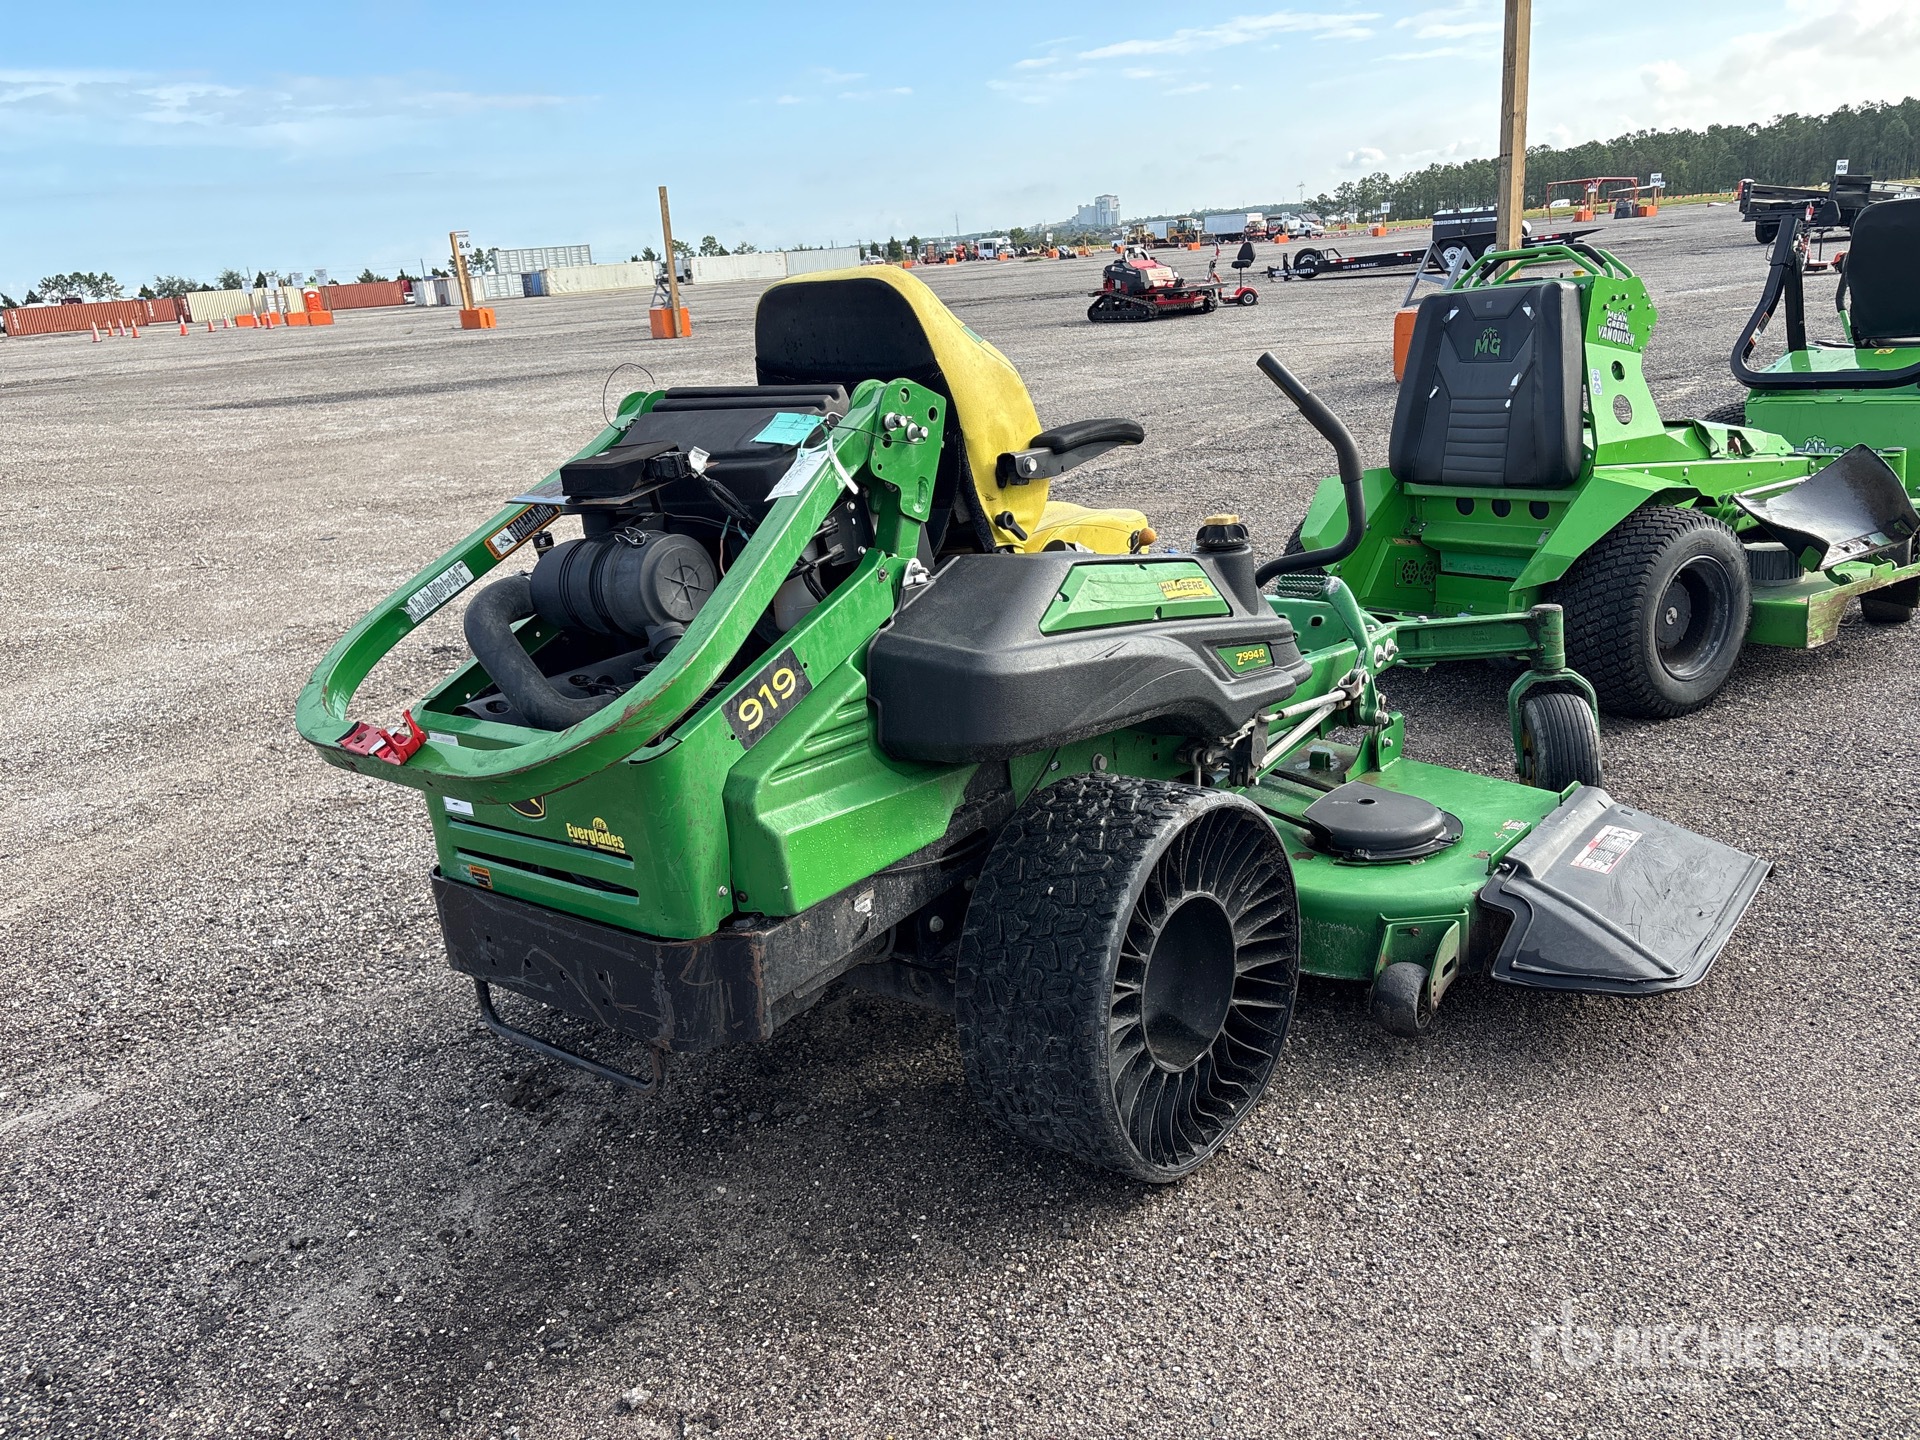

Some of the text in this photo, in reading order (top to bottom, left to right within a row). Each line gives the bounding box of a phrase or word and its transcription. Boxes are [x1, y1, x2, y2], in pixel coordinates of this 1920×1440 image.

[1606, 317, 1629, 332] GREEN
[1607, 310, 1628, 323] MEAN
[1597, 325, 1636, 348] VANQUISH
[1473, 338, 1501, 357] MG
[1235, 648, 1265, 666] Z994R
[738, 667, 797, 731] 919
[565, 822, 625, 849] Everglades
